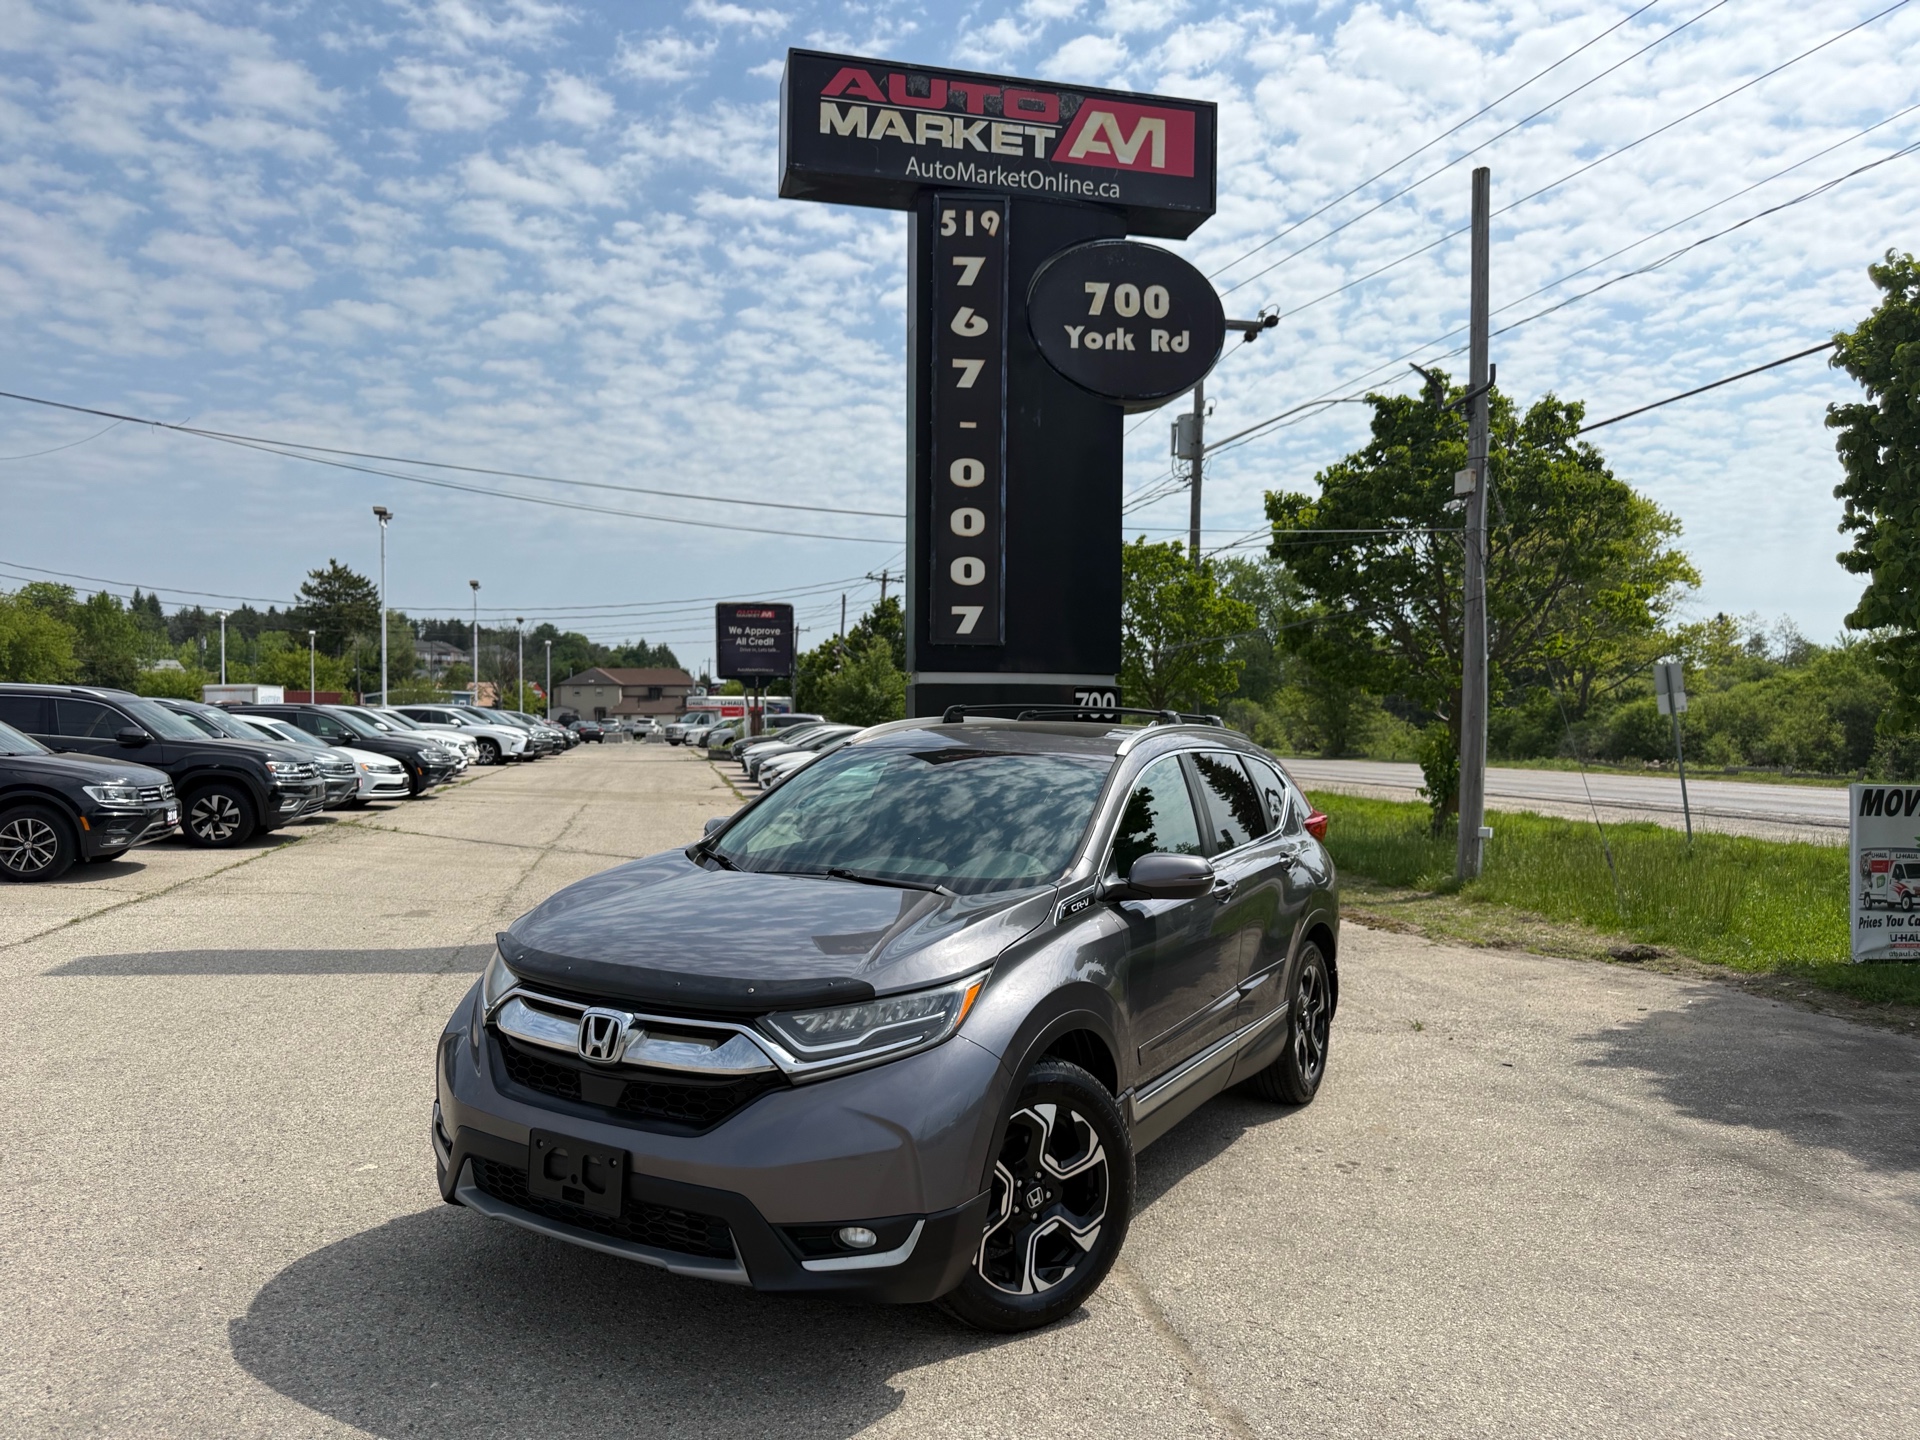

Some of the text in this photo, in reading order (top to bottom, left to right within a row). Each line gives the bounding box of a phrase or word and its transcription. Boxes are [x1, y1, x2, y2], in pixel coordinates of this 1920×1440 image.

[820, 66, 1060, 124] AUTO
[819, 101, 1056, 159] MARKET
[1067, 110, 1166, 169] AM
[905, 156, 1121, 199] AutoMarketOnline.ca
[940, 209, 1000, 238] 519
[1084, 281, 1170, 319] 700
[1063, 324, 1190, 354] York Rd
[728, 626, 781, 637] We Approve
[735, 637, 775, 646] All Credit
[1075, 691, 1116, 719] 700
[1859, 788, 1920, 817] MOV
[1070, 897, 1090, 912] CR-V
[1858, 915, 1883, 930] Prices
[1886, 914, 1905, 928] You
